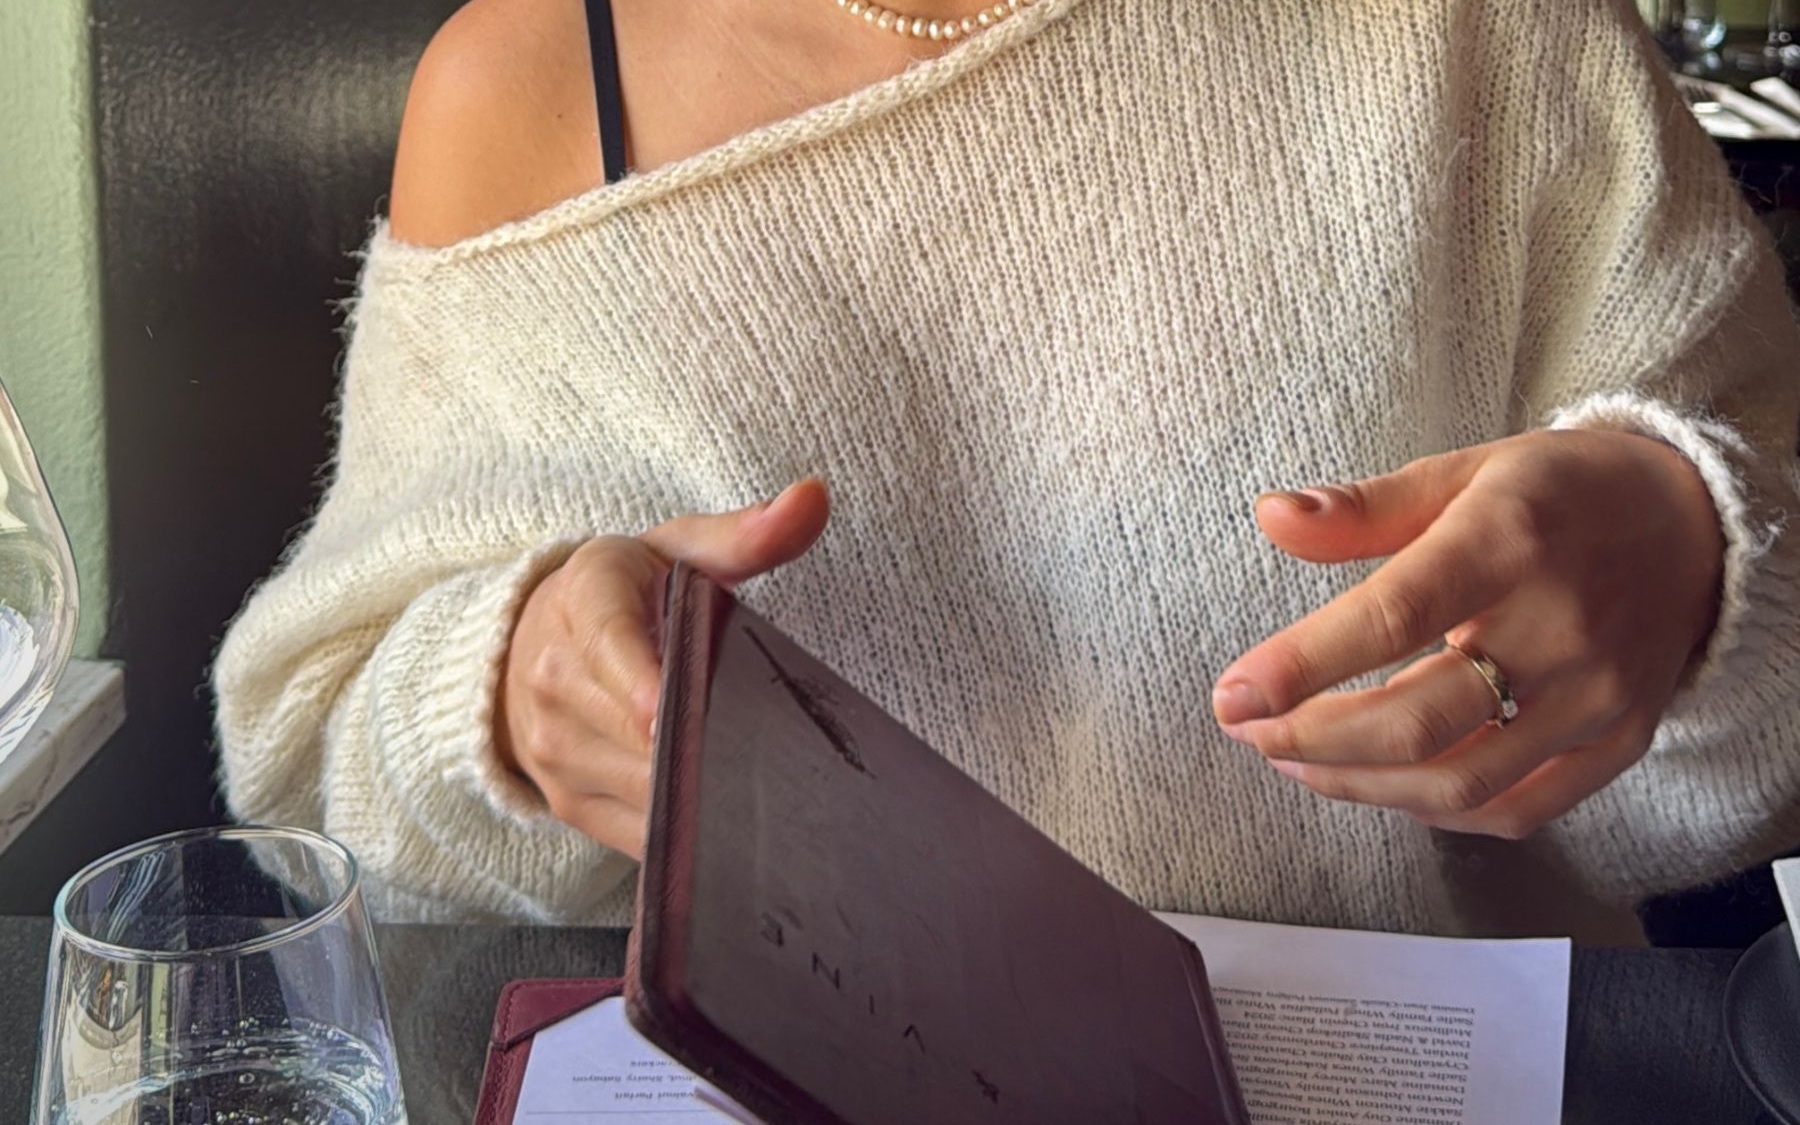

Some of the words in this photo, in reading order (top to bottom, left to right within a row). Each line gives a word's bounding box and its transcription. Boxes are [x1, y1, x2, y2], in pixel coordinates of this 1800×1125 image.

[1236, 1000, 1276, 1011] White
[1280, 1015, 1315, 1024] Blanc
[1319, 1017, 1368, 1028] Chenin
[1389, 1012, 1432, 1023] Family
[1436, 1016, 1473, 1026] Sadie
[1222, 1020, 1251, 1030] Blan
[1254, 1023, 1303, 1034] Chenin
[1372, 1021, 1400, 1031] Iron
[1262, 1033, 1346, 1050] Chardonnay
[1374, 1033, 1413, 1044] Nadia
[1417, 1036, 1428, 1044] &
[1432, 1038, 1471, 1049] David
[1357, 1053, 1388, 1064] Clay
[1423, 1049, 1468, 1061] Jordan
[1332, 1064, 1374, 1075] Wines
[1391, 1058, 1469, 1071] Crystallum
[1311, 1071, 1356, 1084] Morey
[1380, 1066, 1424, 1079] Family
[1429, 1073, 1467, 1082] Sadie
[1240, 1077, 1291, 1090] Vineyar
[1296, 1081, 1340, 1095] Family
[1361, 1077, 1397, 1088] Marc
[1401, 1082, 1465, 1094] Domaine
[614, 1091, 653, 1100] Parfait
[1345, 1087, 1404, 1101] Johnson
[1407, 1093, 1464, 1106] Newton
[1307, 1095, 1350, 1108] Wines
[1355, 1099, 1411, 1113] Mouton
[1316, 1107, 1360, 1120] Amiot
[1415, 1105, 1463, 1117] Sakkie
[1362, 1111, 1392, 1123] Guy
